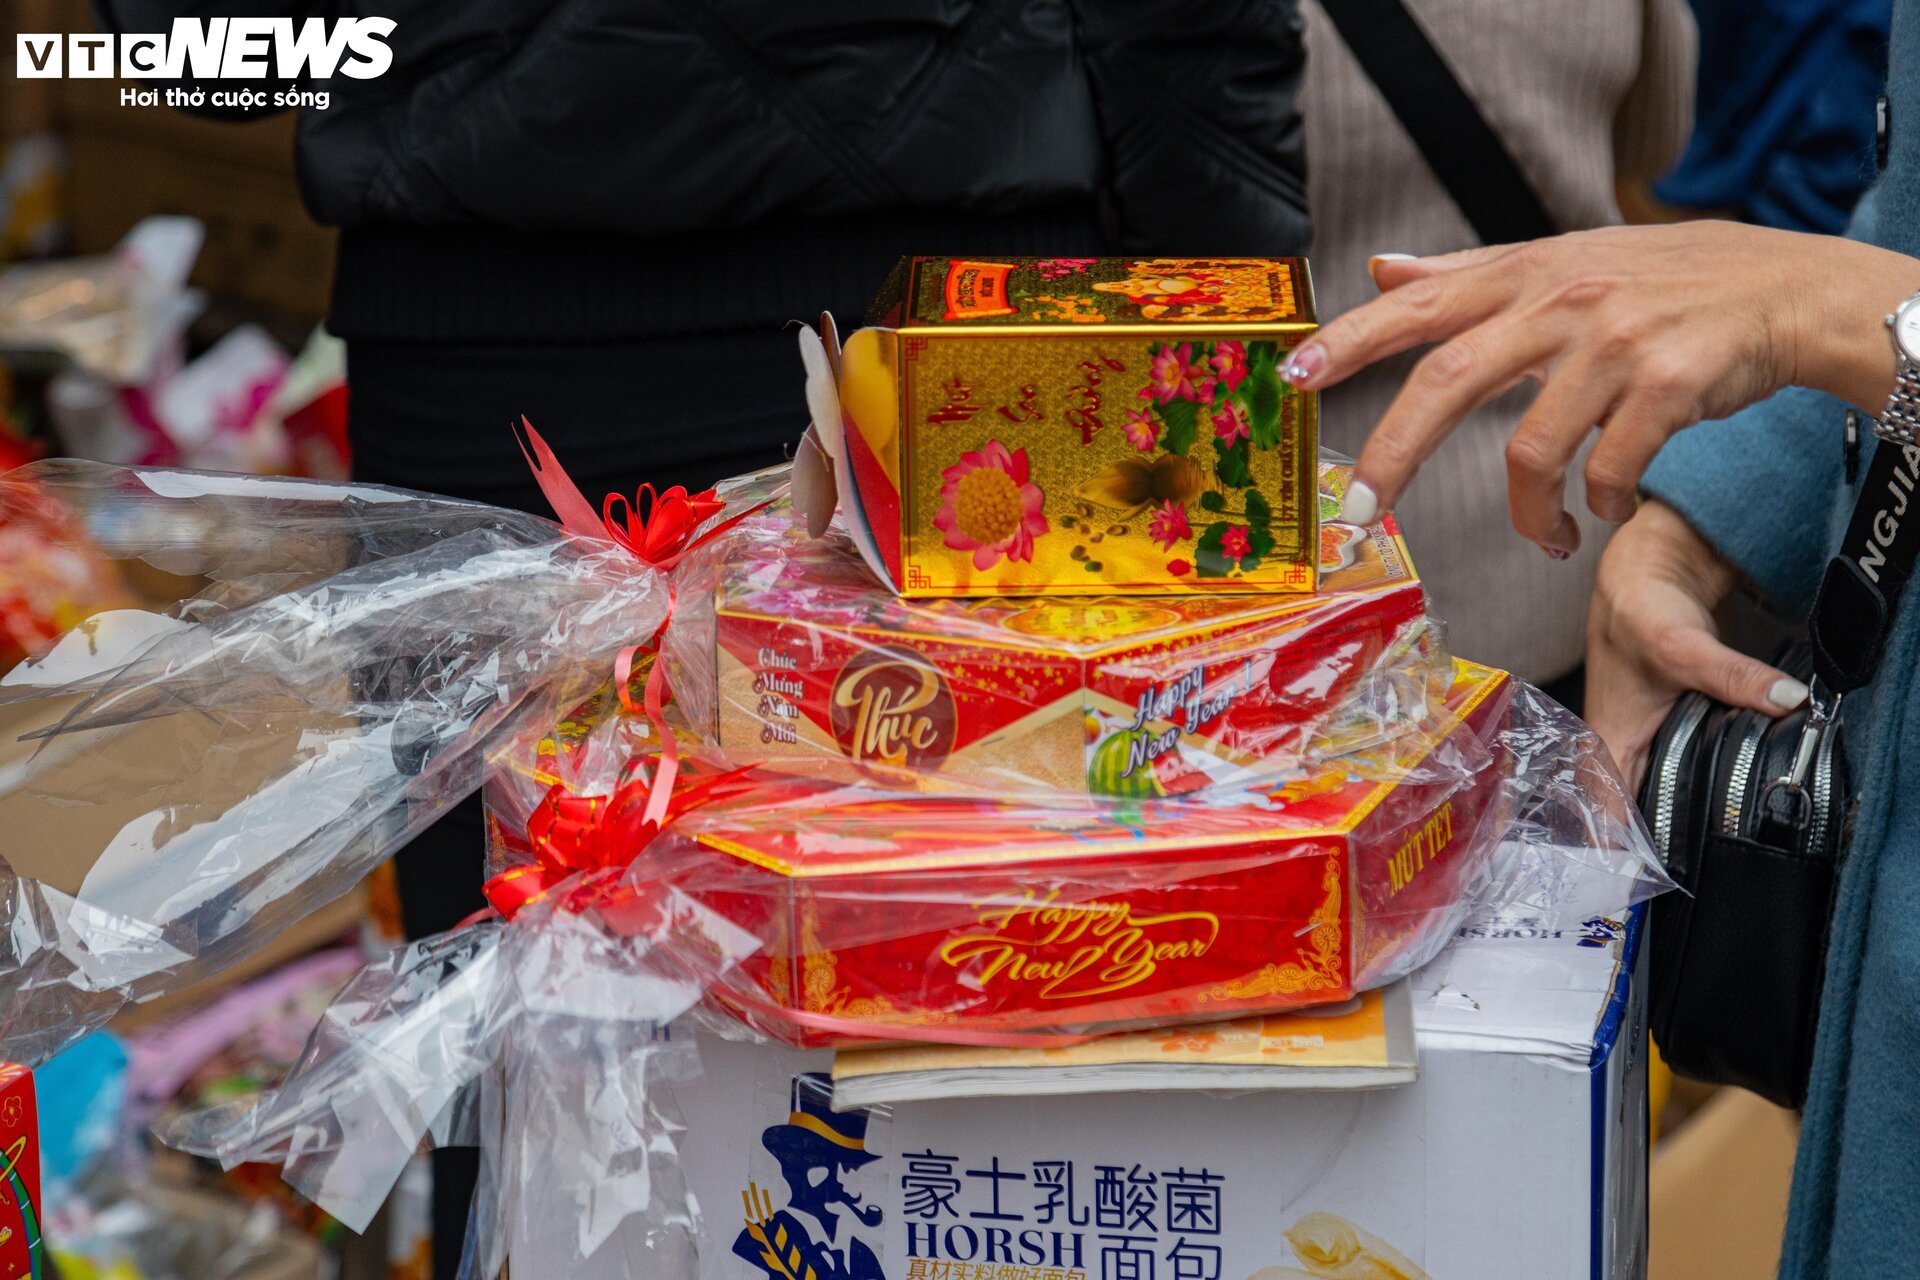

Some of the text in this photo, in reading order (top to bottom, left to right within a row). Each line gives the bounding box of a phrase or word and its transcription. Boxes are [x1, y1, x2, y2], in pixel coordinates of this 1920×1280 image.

[1130, 661, 1204, 731] Happy
[1121, 727, 1181, 778] New
[971, 888, 1134, 944] Happy
[940, 926, 1212, 998] New Year
[901, 1149, 1225, 1236] 豪士乳酸菌
[905, 1222, 1087, 1270] HORSH
